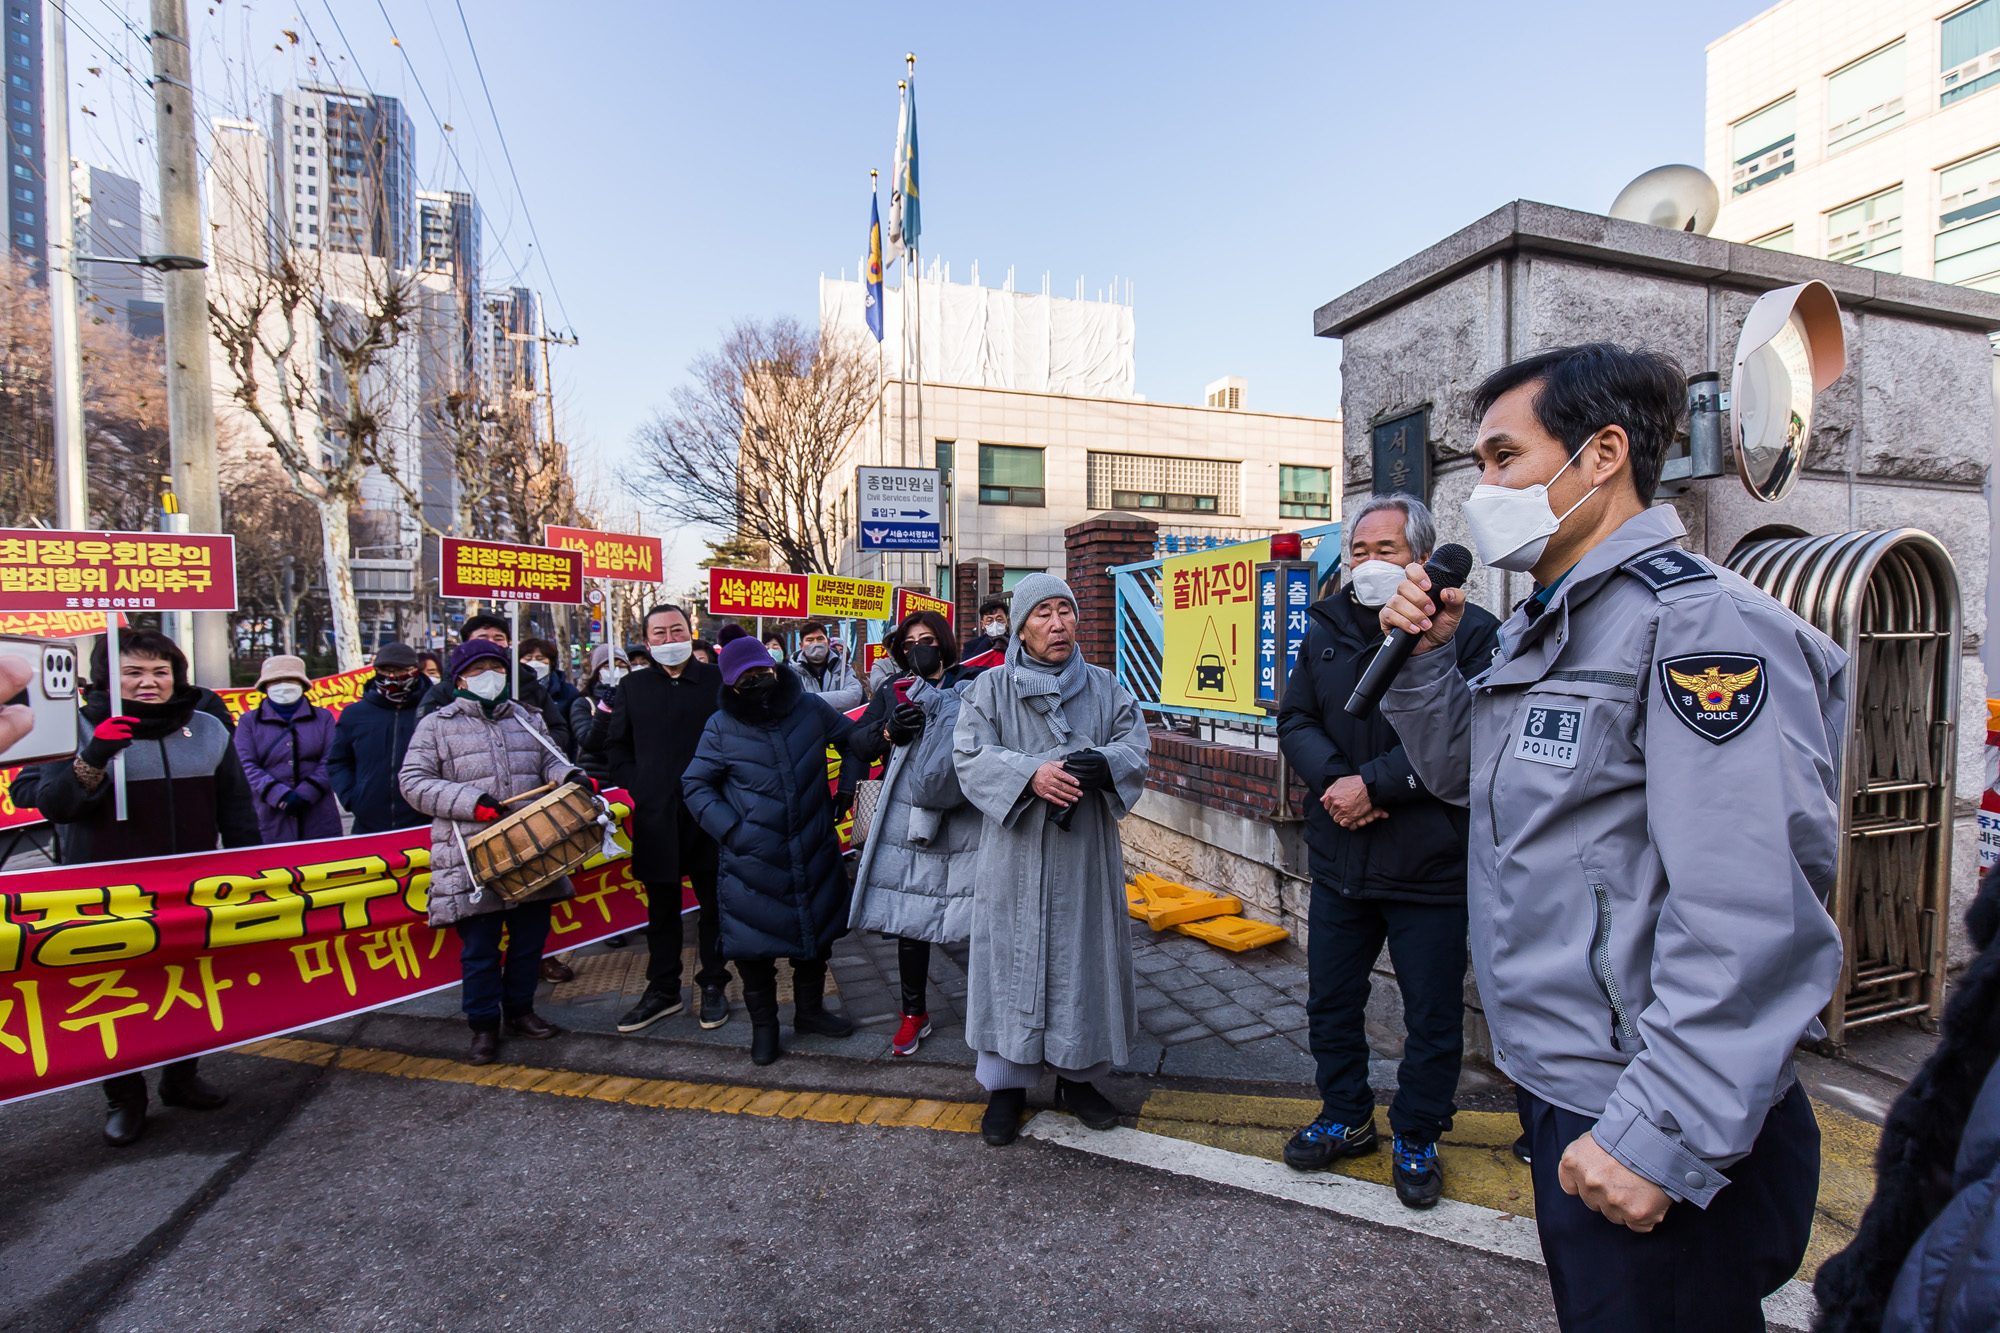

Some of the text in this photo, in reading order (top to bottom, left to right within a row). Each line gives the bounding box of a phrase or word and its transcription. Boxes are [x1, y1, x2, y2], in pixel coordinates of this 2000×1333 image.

[1387, 425, 1412, 488] 서울
[867, 475, 934, 493] 종합민원실
[866, 492, 934, 503] Civil Services Center
[871, 507, 897, 518] 출입구
[0, 538, 211, 567] 최정우회장의
[456, 545, 571, 573] 최정우회장의
[0, 567, 213, 593] 범죄행위 사익추구
[456, 565, 571, 591] 범죄행위 사익추구
[816, 579, 886, 599] 내부정보 이용한
[1173, 558, 1254, 610] 출차주의
[66, 597, 156, 608] 포항참여연대
[719, 577, 800, 610] 신속·엄정수사
[1696, 711, 1739, 721] POLICE
[1522, 740, 1573, 760] POLICE
